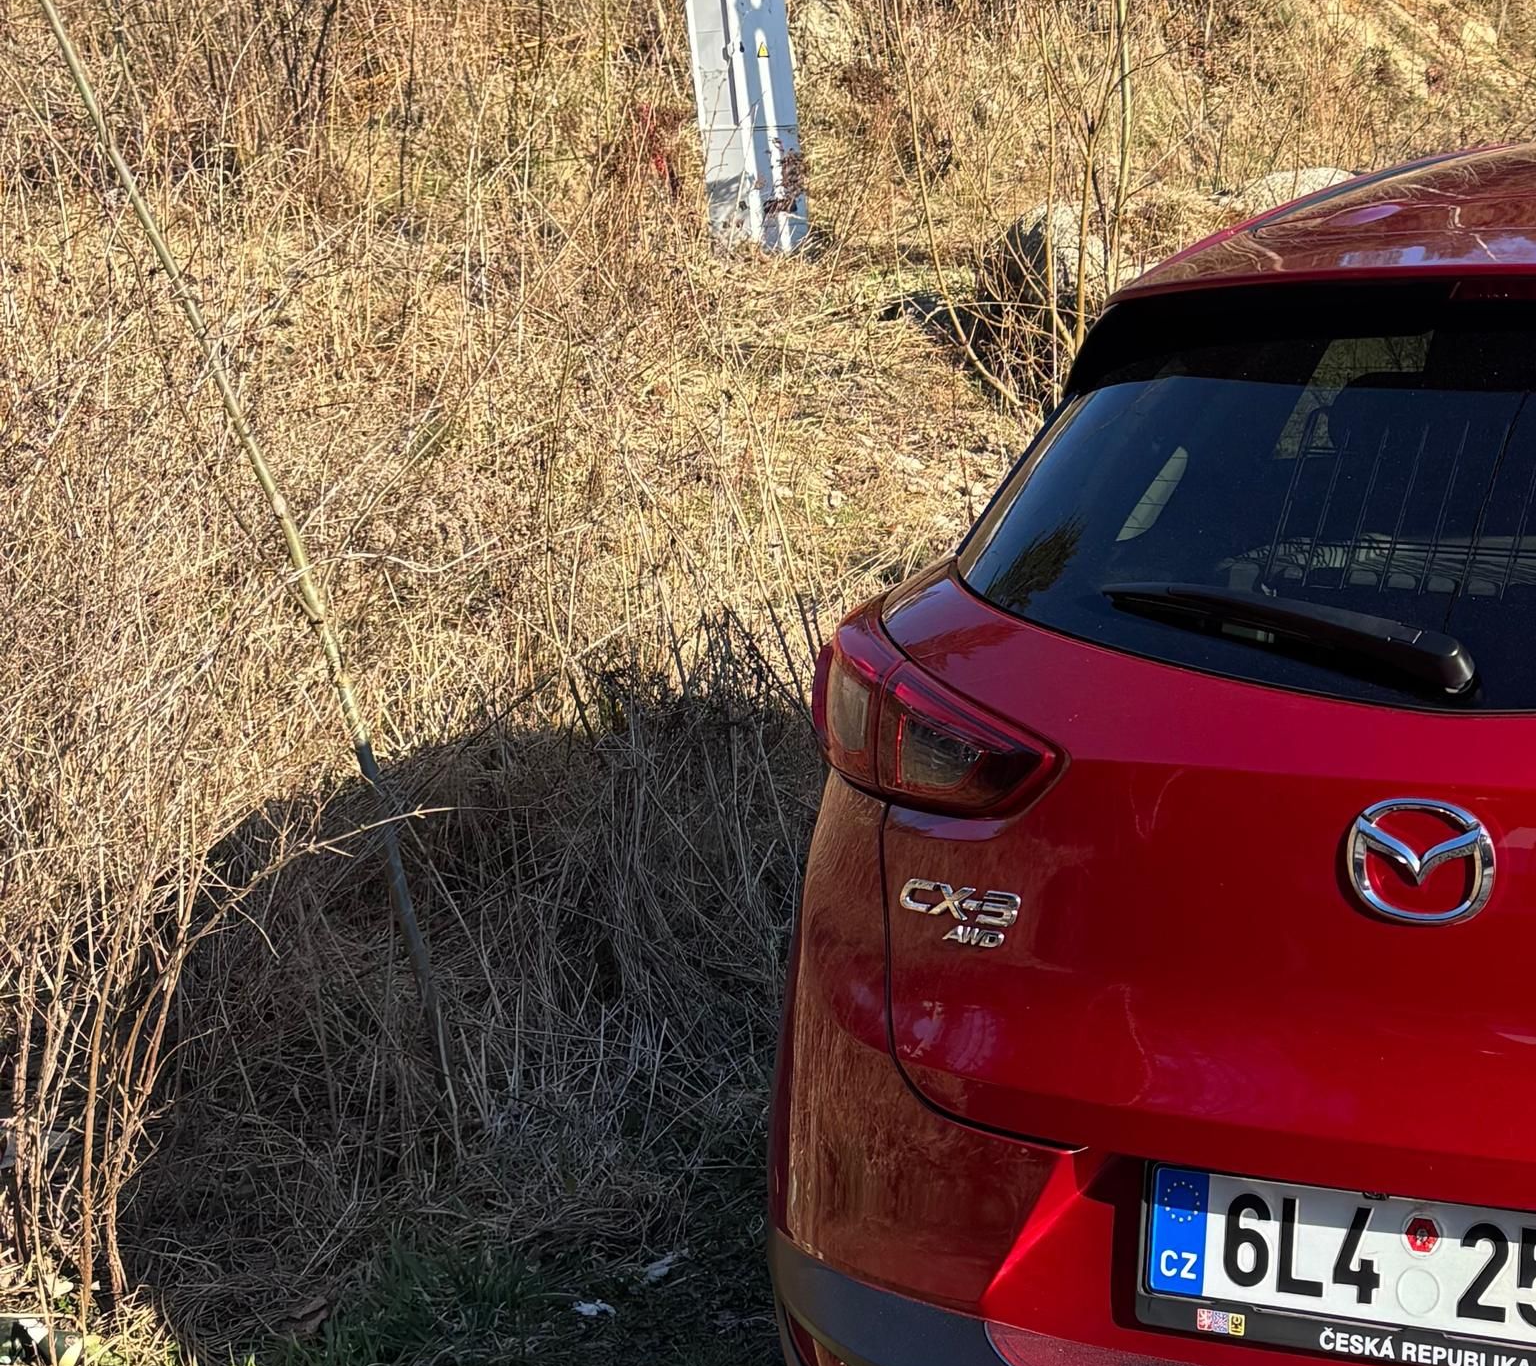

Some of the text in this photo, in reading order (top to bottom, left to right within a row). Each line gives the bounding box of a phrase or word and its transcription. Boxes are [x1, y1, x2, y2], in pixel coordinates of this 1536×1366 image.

[899, 878, 1022, 927] CX-3
[942, 925, 1004, 948] AWD
[1222, 1192, 1381, 1304] 6L4
[1159, 1249, 1198, 1281] CZ
[1319, 1327, 1395, 1360] ČESKÁ
